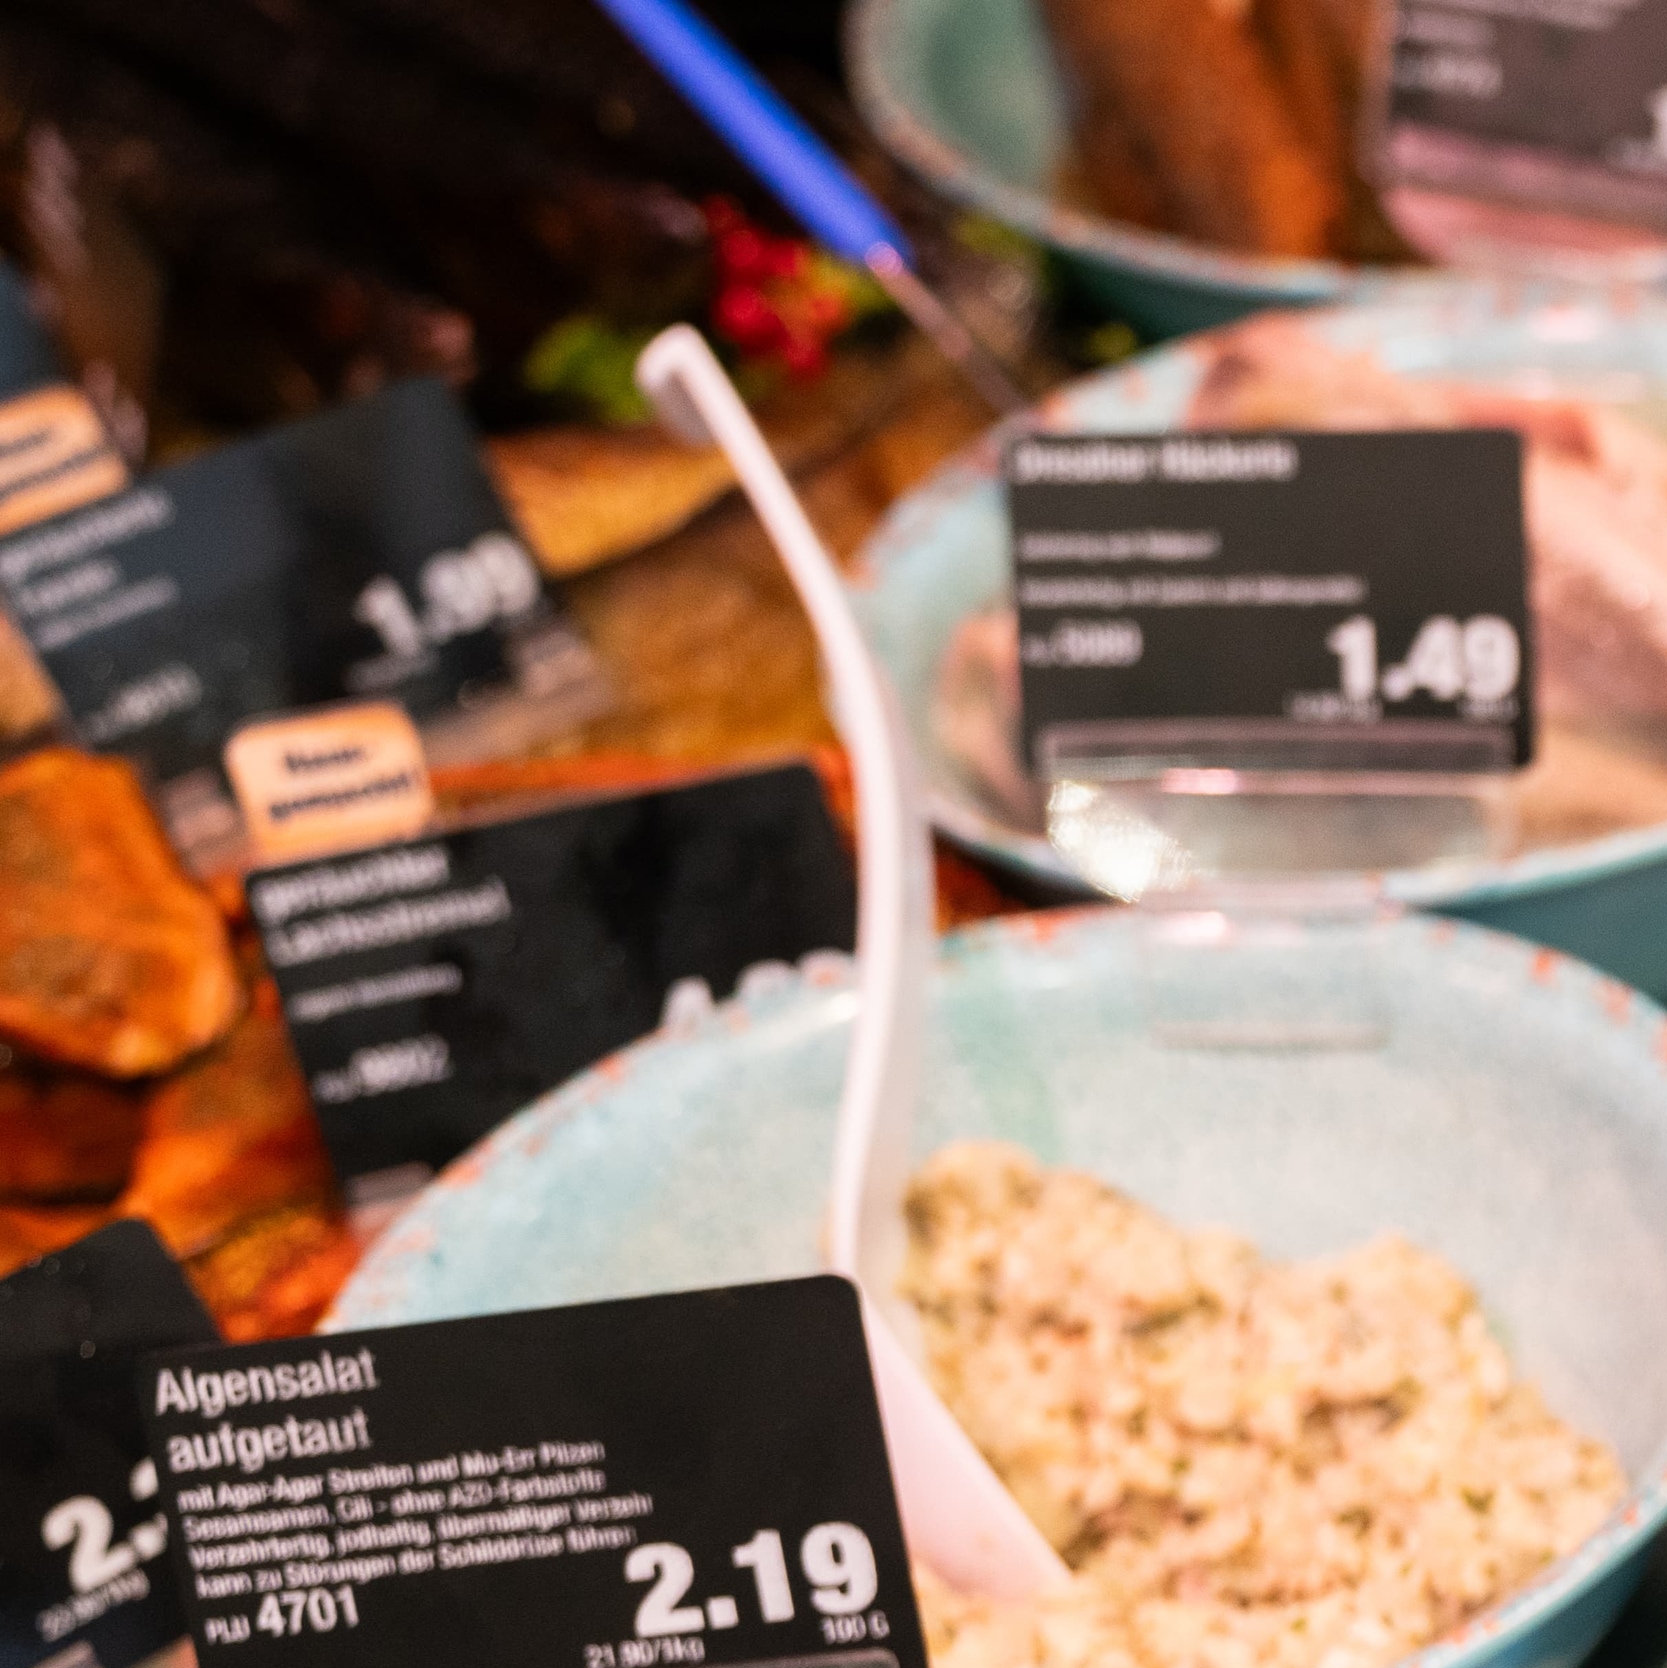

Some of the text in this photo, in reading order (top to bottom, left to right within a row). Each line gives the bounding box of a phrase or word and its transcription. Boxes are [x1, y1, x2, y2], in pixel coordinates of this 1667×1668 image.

[1327, 615, 1521, 701] 1.49
[155, 1350, 377, 1417] Algensalat
[168, 1410, 370, 1472] aufgetaut
[326, 1463, 416, 1494] Streifen
[414, 1455, 462, 1484] und
[389, 1488, 448, 1516] ohne
[254, 1568, 285, 1593] zu
[396, 1547, 436, 1574] der
[624, 1521, 878, 1637] 2.19
[203, 1584, 360, 1644] PLU 4701
[821, 1610, 892, 1642] 100 G
